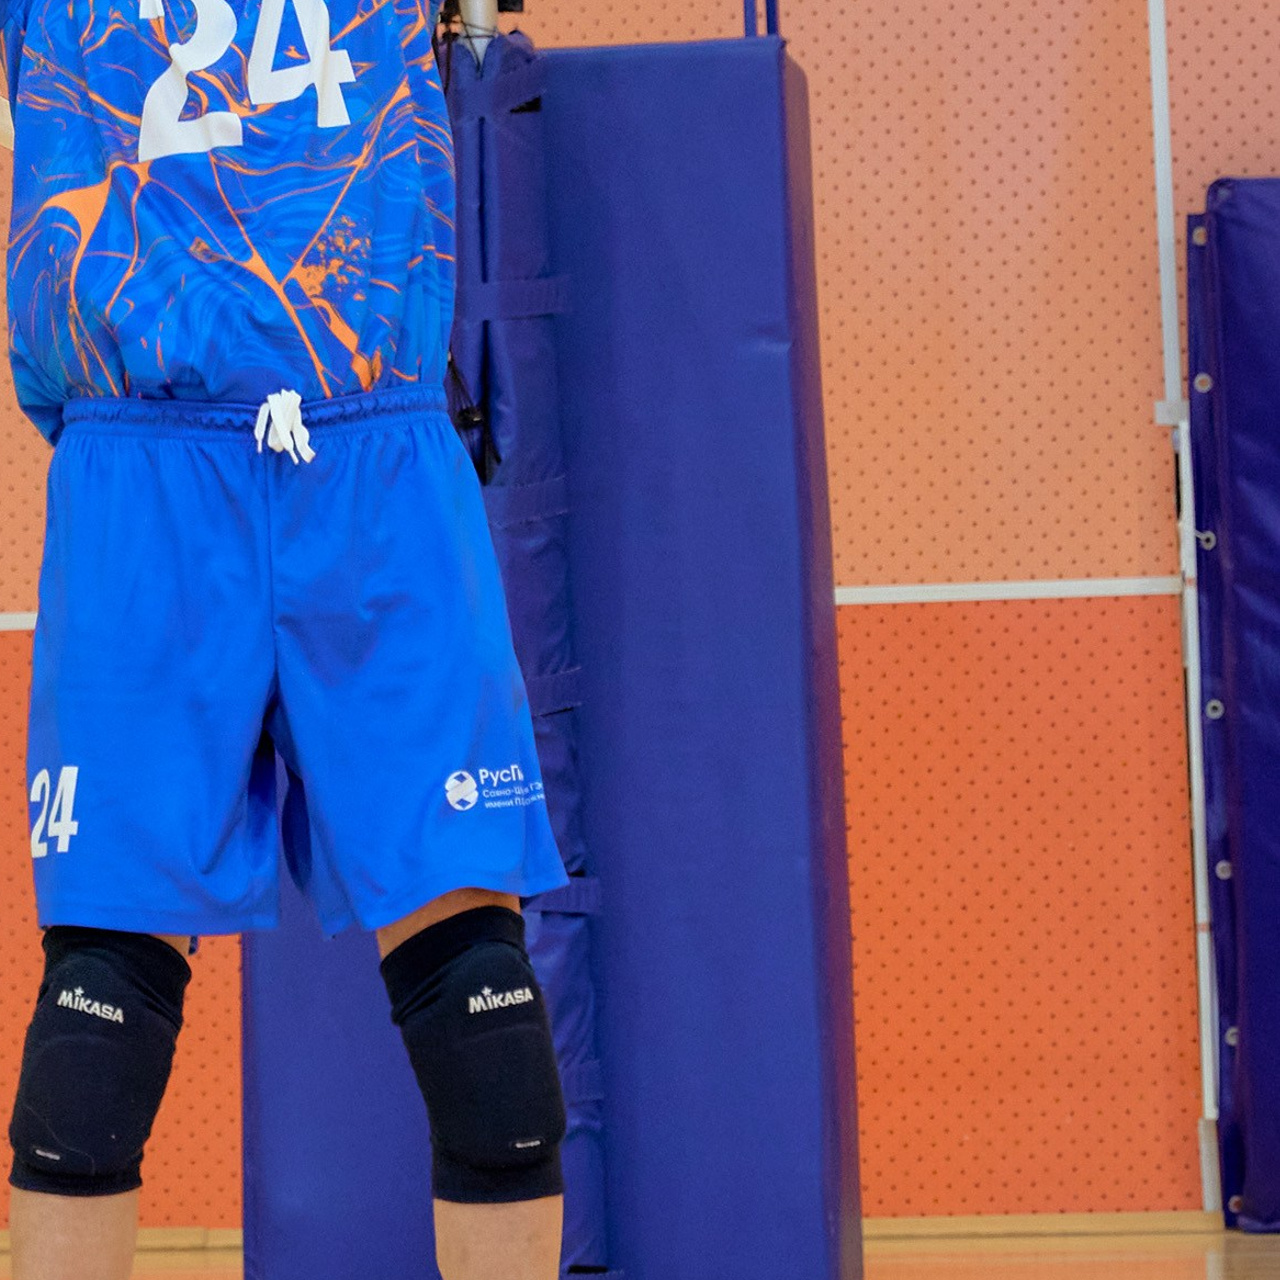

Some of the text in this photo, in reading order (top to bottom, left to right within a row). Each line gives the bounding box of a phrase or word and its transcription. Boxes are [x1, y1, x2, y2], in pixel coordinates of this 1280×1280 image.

[30, 766, 79, 858] 24
[56, 985, 124, 1024] MIKASA
[468, 985, 534, 1014] MIKASA
